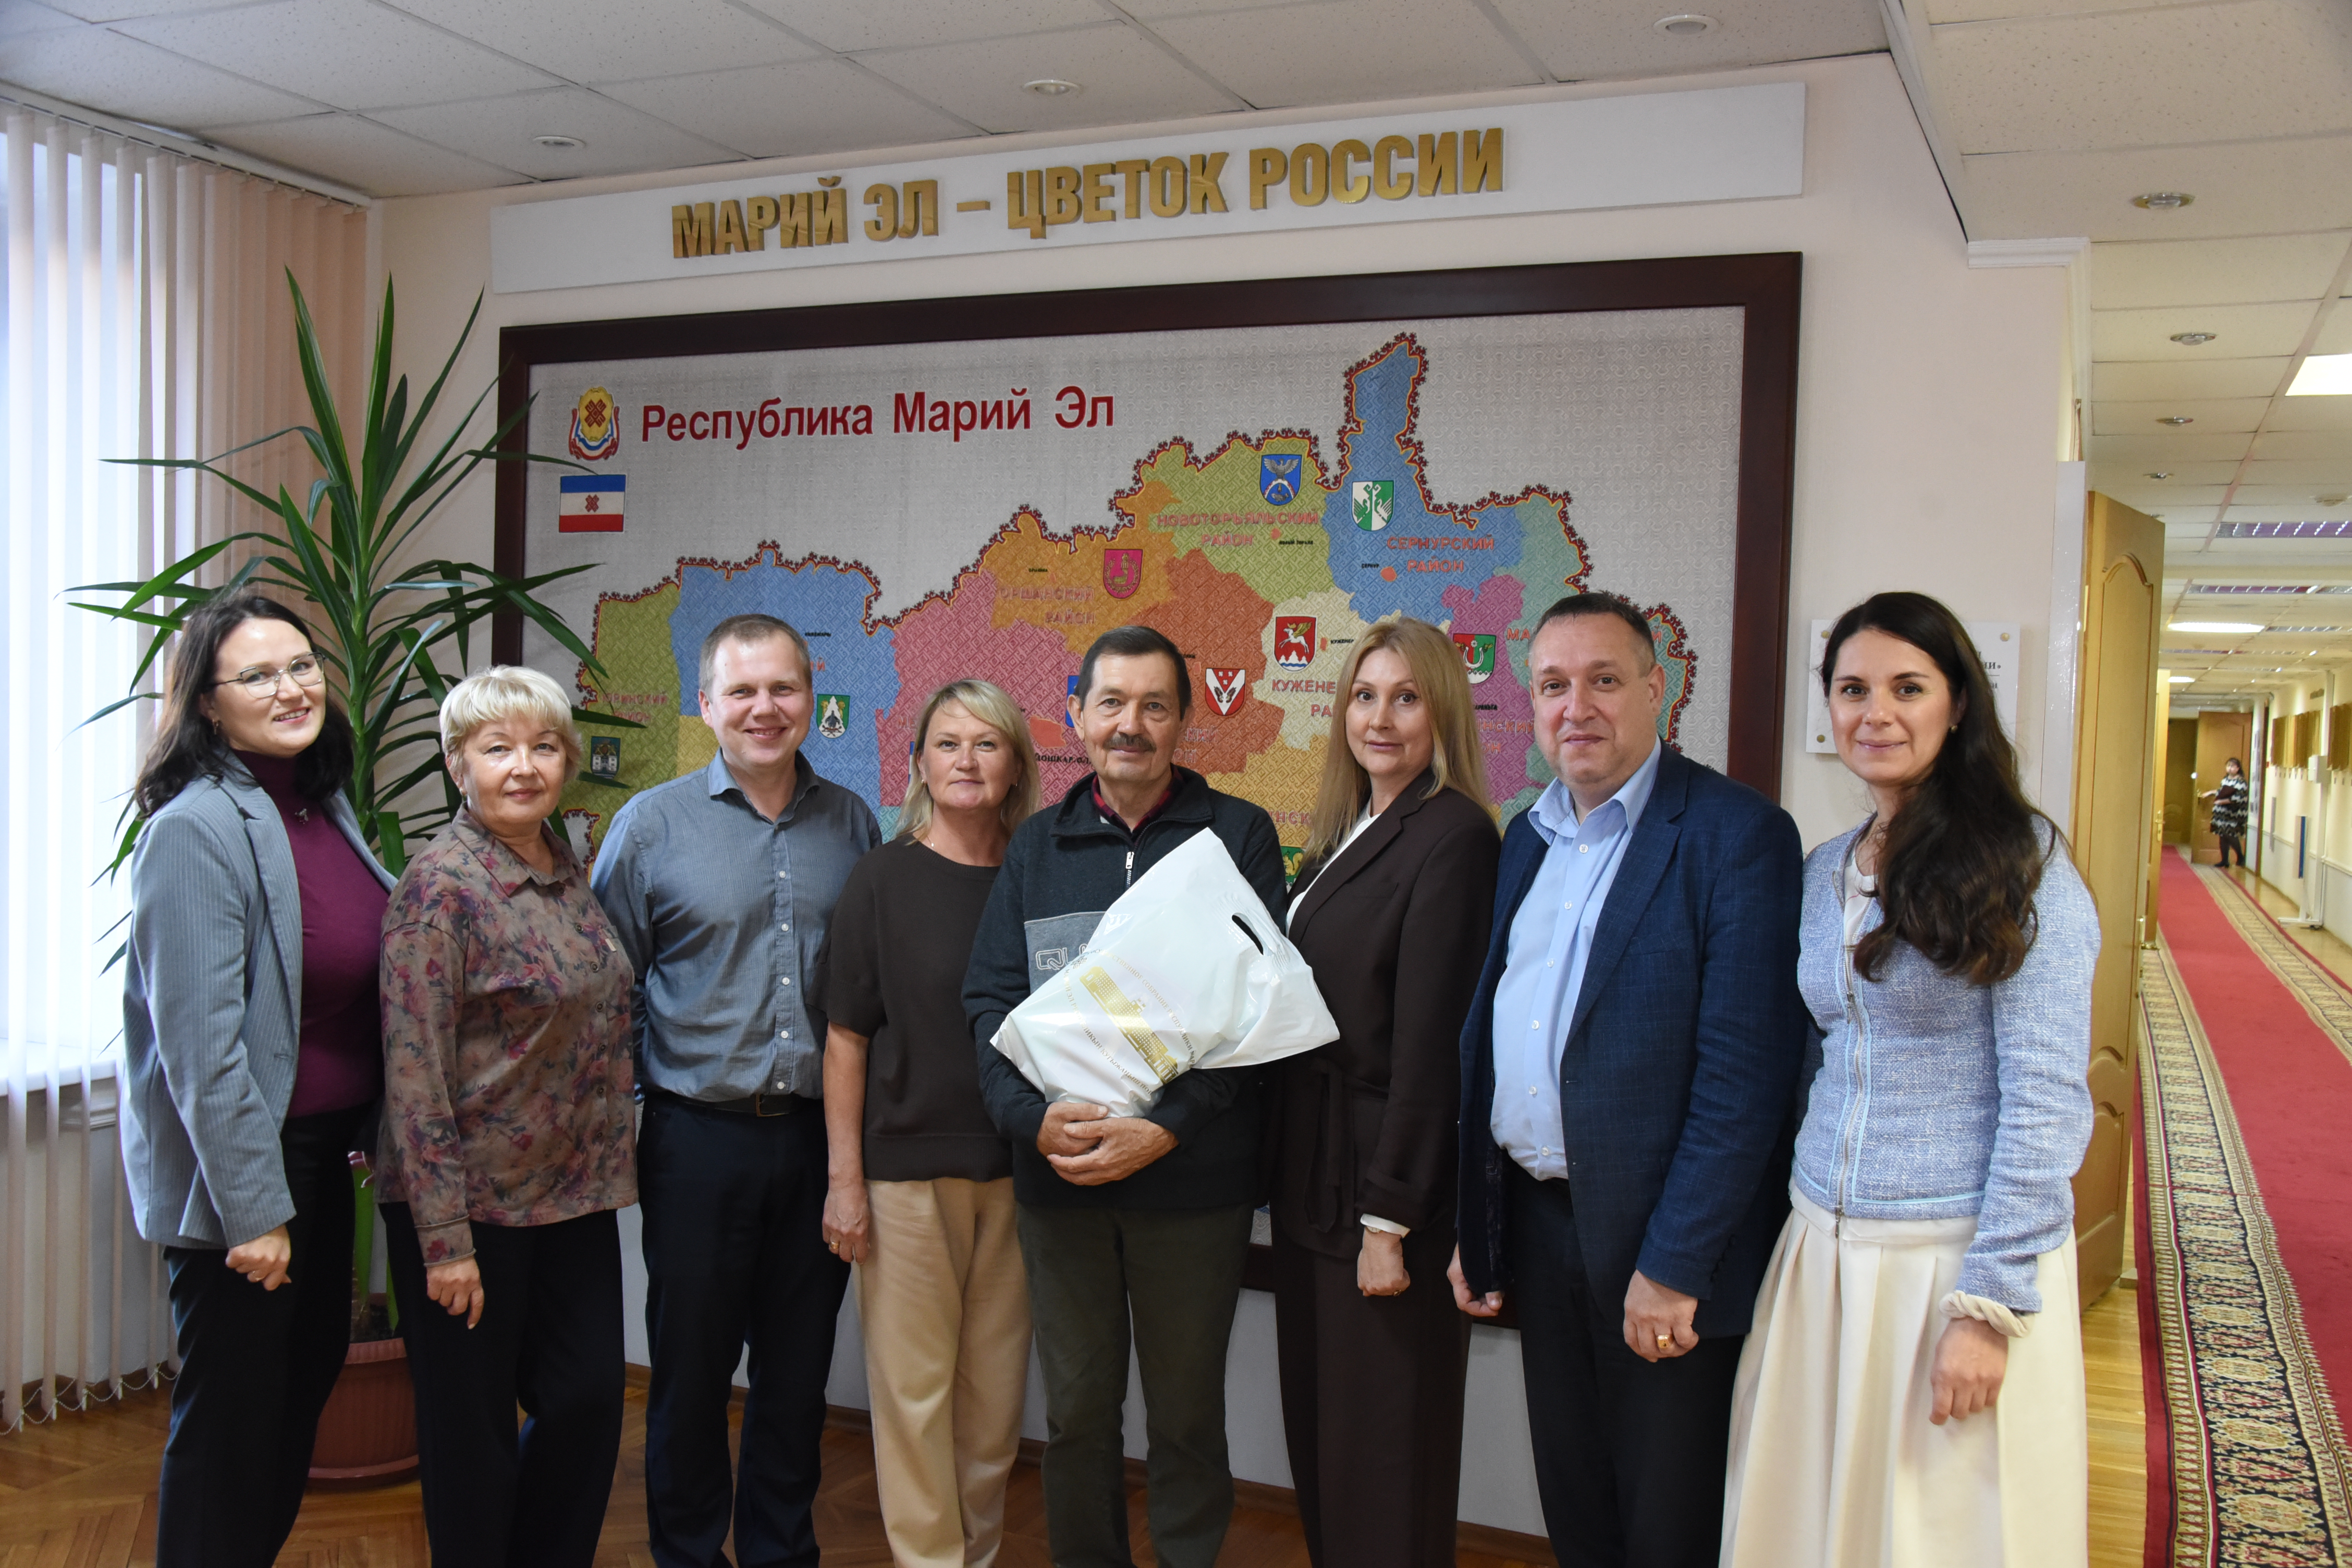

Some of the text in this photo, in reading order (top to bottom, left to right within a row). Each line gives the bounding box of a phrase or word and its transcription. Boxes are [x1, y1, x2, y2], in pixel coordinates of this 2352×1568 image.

[672, 176, 849, 258] МАРИЙ
[863, 179, 939, 242] ЭЛ
[1007, 151, 1229, 239] ЦВЕТОК
[1250, 128, 1504, 210] РОССИИ
[642, 386, 1114, 450] Республика Марий Эл
[1157, 508, 1318, 526] НОВОТОРЪЯЛЬСКИЙ
[1201, 530, 1253, 546] РАЙОН
[1387, 534, 1494, 550] СЕРНУРСКИЙ
[1407, 556, 1464, 573] РАЙОН
[1000, 586, 1094, 601] ОРШАНСКИЙ
[1045, 608, 1095, 624] РАЙОН
[1272, 679, 1336, 694] КУЖЕНЕ
[1035, 753, 1092, 764] ЙОШКАР-ОЛ
[1142, 979, 1169, 1010] СОБРАНИЕ
[1071, 1002, 1102, 1049] РЕЛИКЫН
